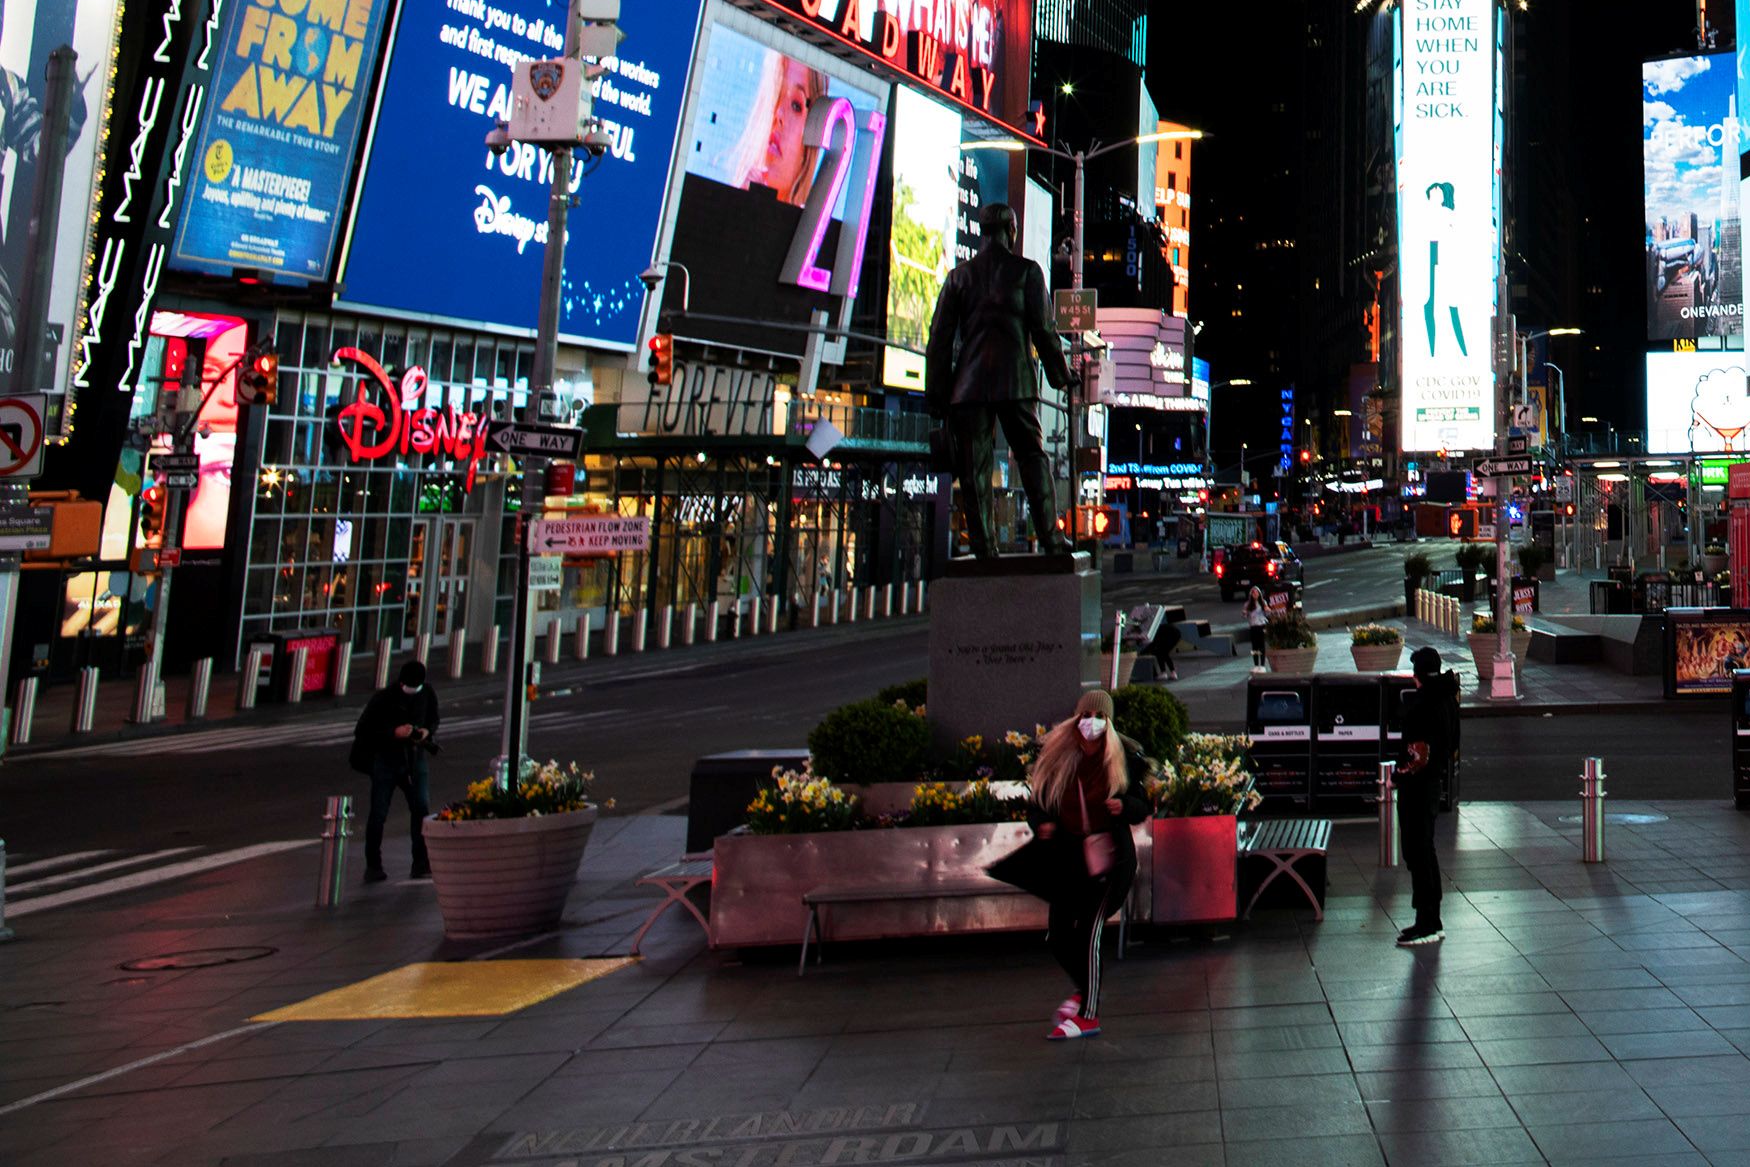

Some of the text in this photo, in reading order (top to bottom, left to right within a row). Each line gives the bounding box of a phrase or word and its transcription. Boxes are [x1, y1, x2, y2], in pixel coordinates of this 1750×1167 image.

[1416, 16, 1478, 32] HOME
[484, 6, 512, 30] you
[512, 13, 527, 35] to
[526, 19, 544, 43] all
[543, 23, 564, 51] the
[620, 54, 660, 89] workers
[1416, 37, 1478, 53] WHEN
[439, 24, 468, 47] and
[468, 27, 496, 60] first
[601, 81, 620, 102] the
[620, 85, 652, 116] world.
[1416, 59, 1460, 75] YOU
[448, 66, 490, 115] WE
[1416, 81, 1457, 97] ARE
[220, 69, 355, 138] AWAY
[1416, 102, 1470, 119] SICK.
[216, 114, 341, 155] THE REMARKABLE TRUE STORY
[797, 96, 886, 300] 21
[473, 183, 536, 255] Disney
[1069, 293, 1082, 304] TO
[1059, 304, 1069, 315] W
[1081, 304, 1091, 315] St
[336, 346, 490, 495] Disney
[500, 429, 570, 450] ONE WAY
[1482, 460, 1525, 474] ONE WAY
[1557, 485, 1570, 494] 25
[545, 520, 644, 535] PEDESTRIAN FLOW ZONE
[588, 535, 643, 547] KEEP MOVING
[1513, 586, 1535, 601] JERSEY
